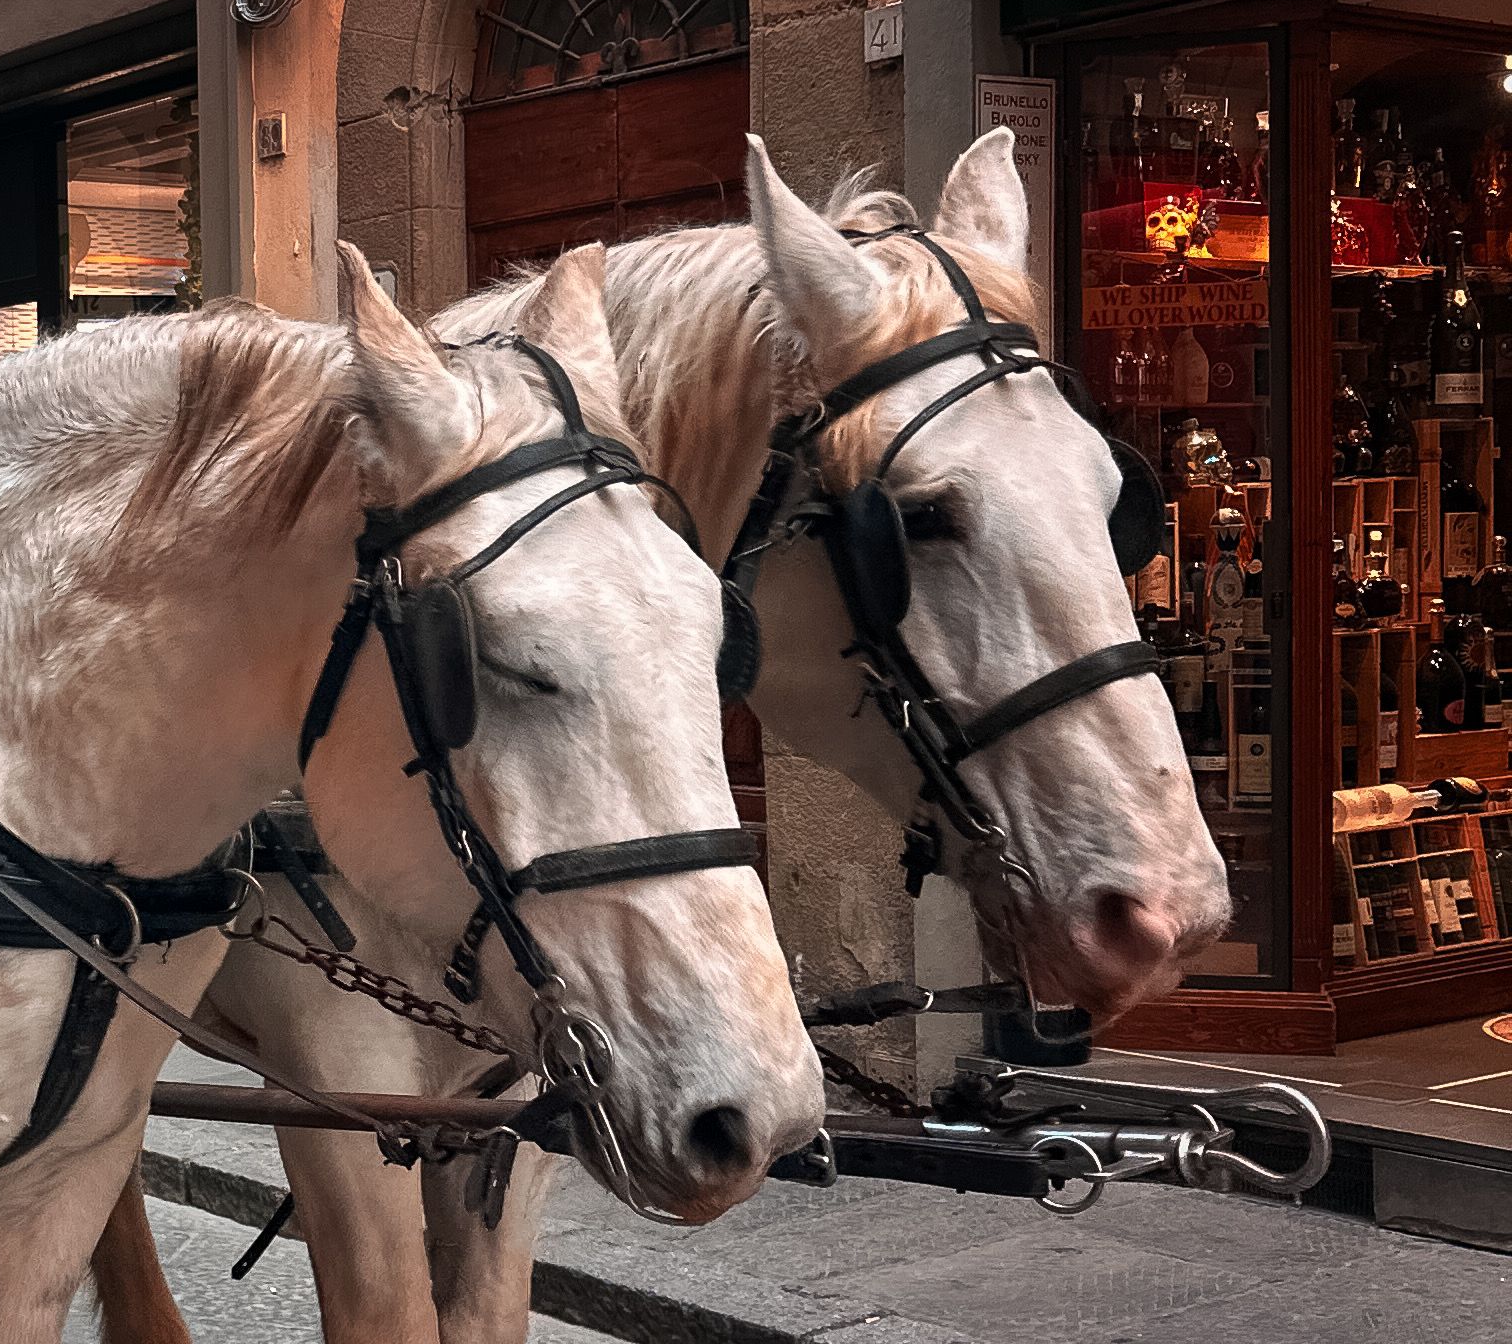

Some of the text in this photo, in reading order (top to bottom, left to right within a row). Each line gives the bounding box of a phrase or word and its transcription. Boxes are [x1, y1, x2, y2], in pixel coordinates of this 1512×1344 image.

[870, 16, 898, 52] 41
[983, 92, 1049, 110] BRUNELLO
[991, 111, 1041, 128] BAROLO
[1101, 283, 1255, 306] WE SHIP WINE
[1088, 302, 1266, 327] ALL OVER WORLD
